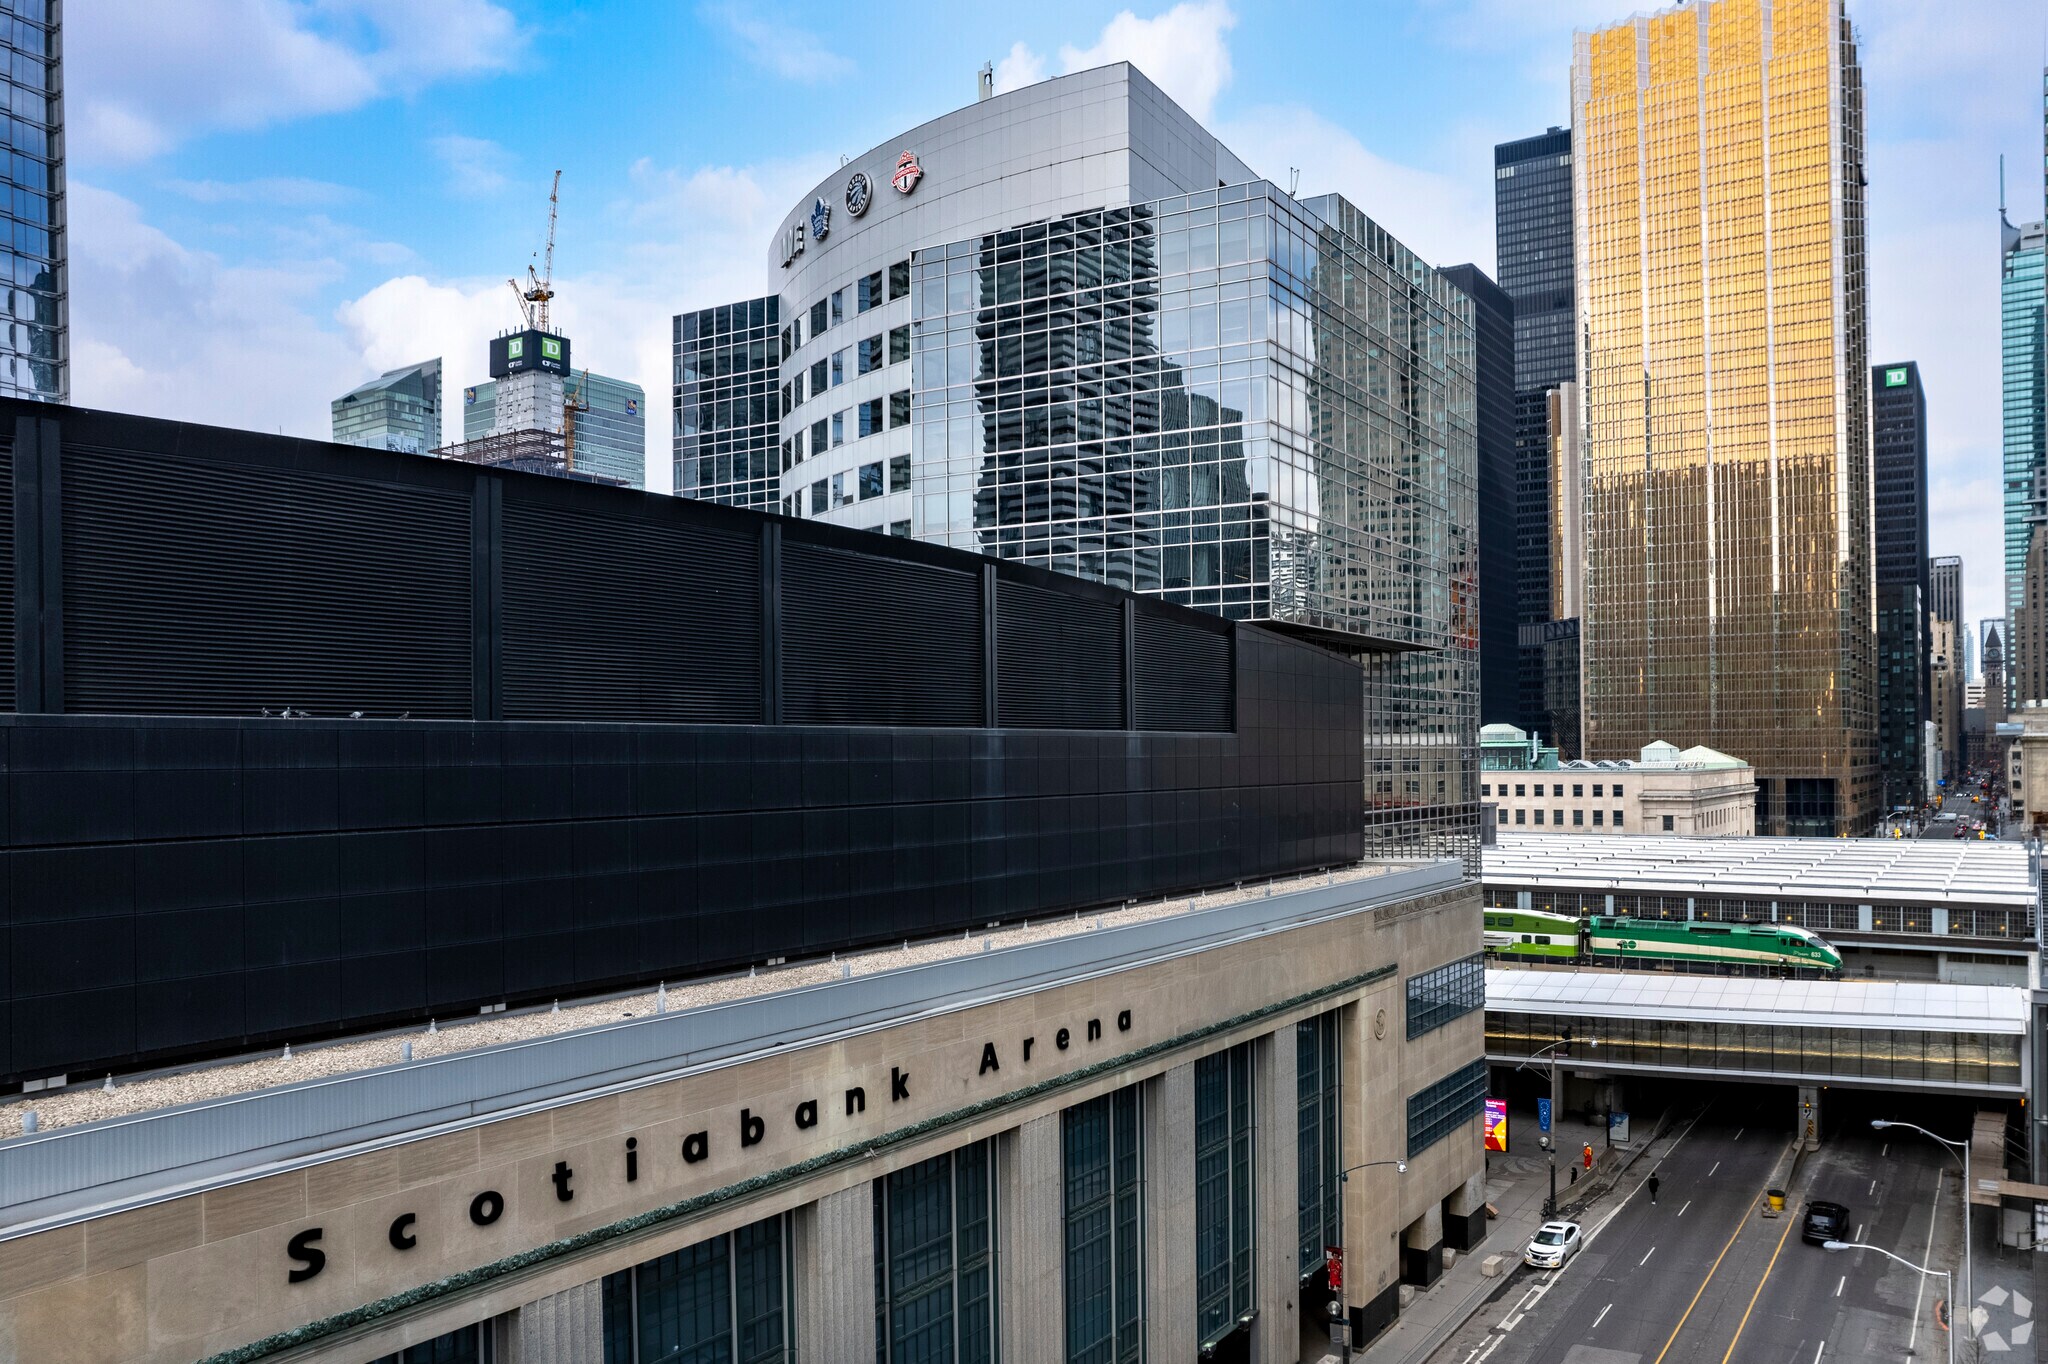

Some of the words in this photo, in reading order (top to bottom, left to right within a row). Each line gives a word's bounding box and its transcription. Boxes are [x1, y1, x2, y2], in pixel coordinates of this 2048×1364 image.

[847, 174, 866, 194] TORONTO
[509, 340, 521, 355] TD
[543, 340, 559, 355] TD
[1887, 370, 1906, 383] TD
[287, 1066, 910, 1284] Scotiabank
[978, 1008, 1132, 1076] Arena
